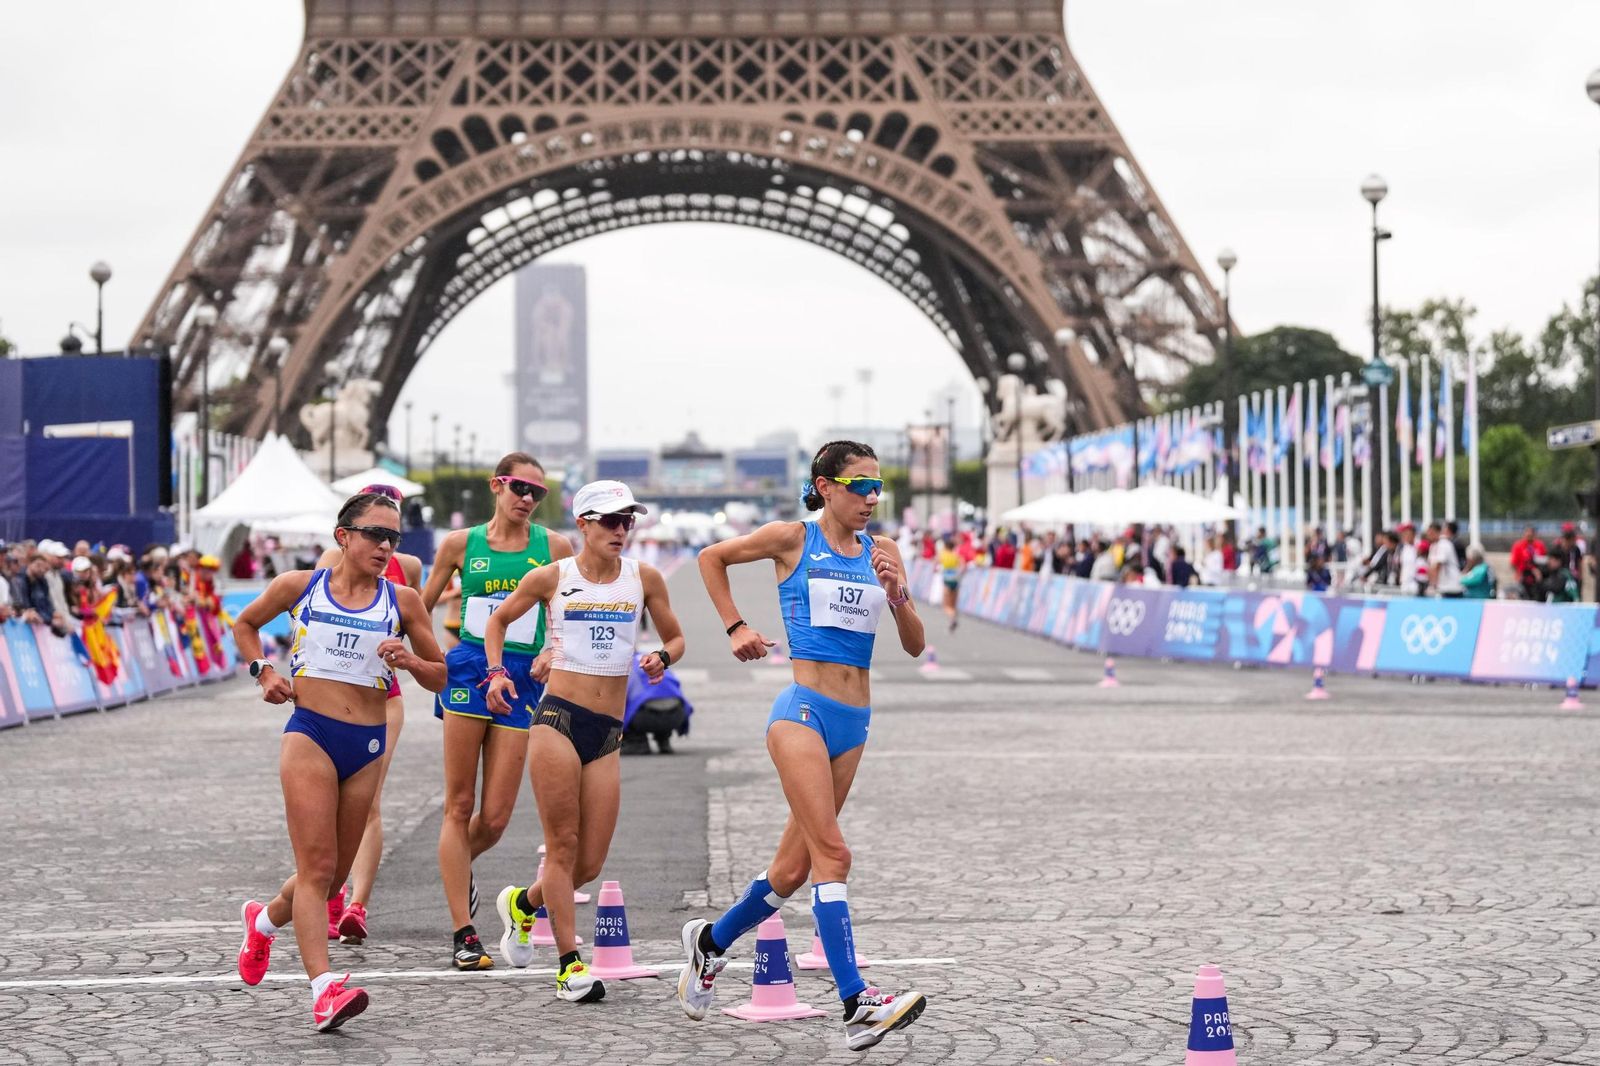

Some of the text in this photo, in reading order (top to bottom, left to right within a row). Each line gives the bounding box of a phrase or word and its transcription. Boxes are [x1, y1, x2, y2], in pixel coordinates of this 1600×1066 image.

[829, 571, 850, 579] PARIS
[485, 579, 521, 593] BRAS
[838, 586, 864, 605] 137
[829, 603, 870, 617] PALMISANO
[1168, 599, 1208, 622] PARIS
[330, 616, 372, 629] PARIS 2024
[1503, 617, 1564, 641] PARIS
[589, 626, 615, 640] 123
[1164, 621, 1204, 644] 2024
[336, 631, 360, 649] 117
[592, 642, 613, 650] PEREZ
[325, 647, 365, 661] MOREJON
[1501, 640, 1559, 665] 2024
[595, 917, 623, 926] PARIS
[595, 927, 623, 937] 2024
[1204, 1012, 1229, 1024] PAR
[1206, 1024, 1231, 1038] 202
